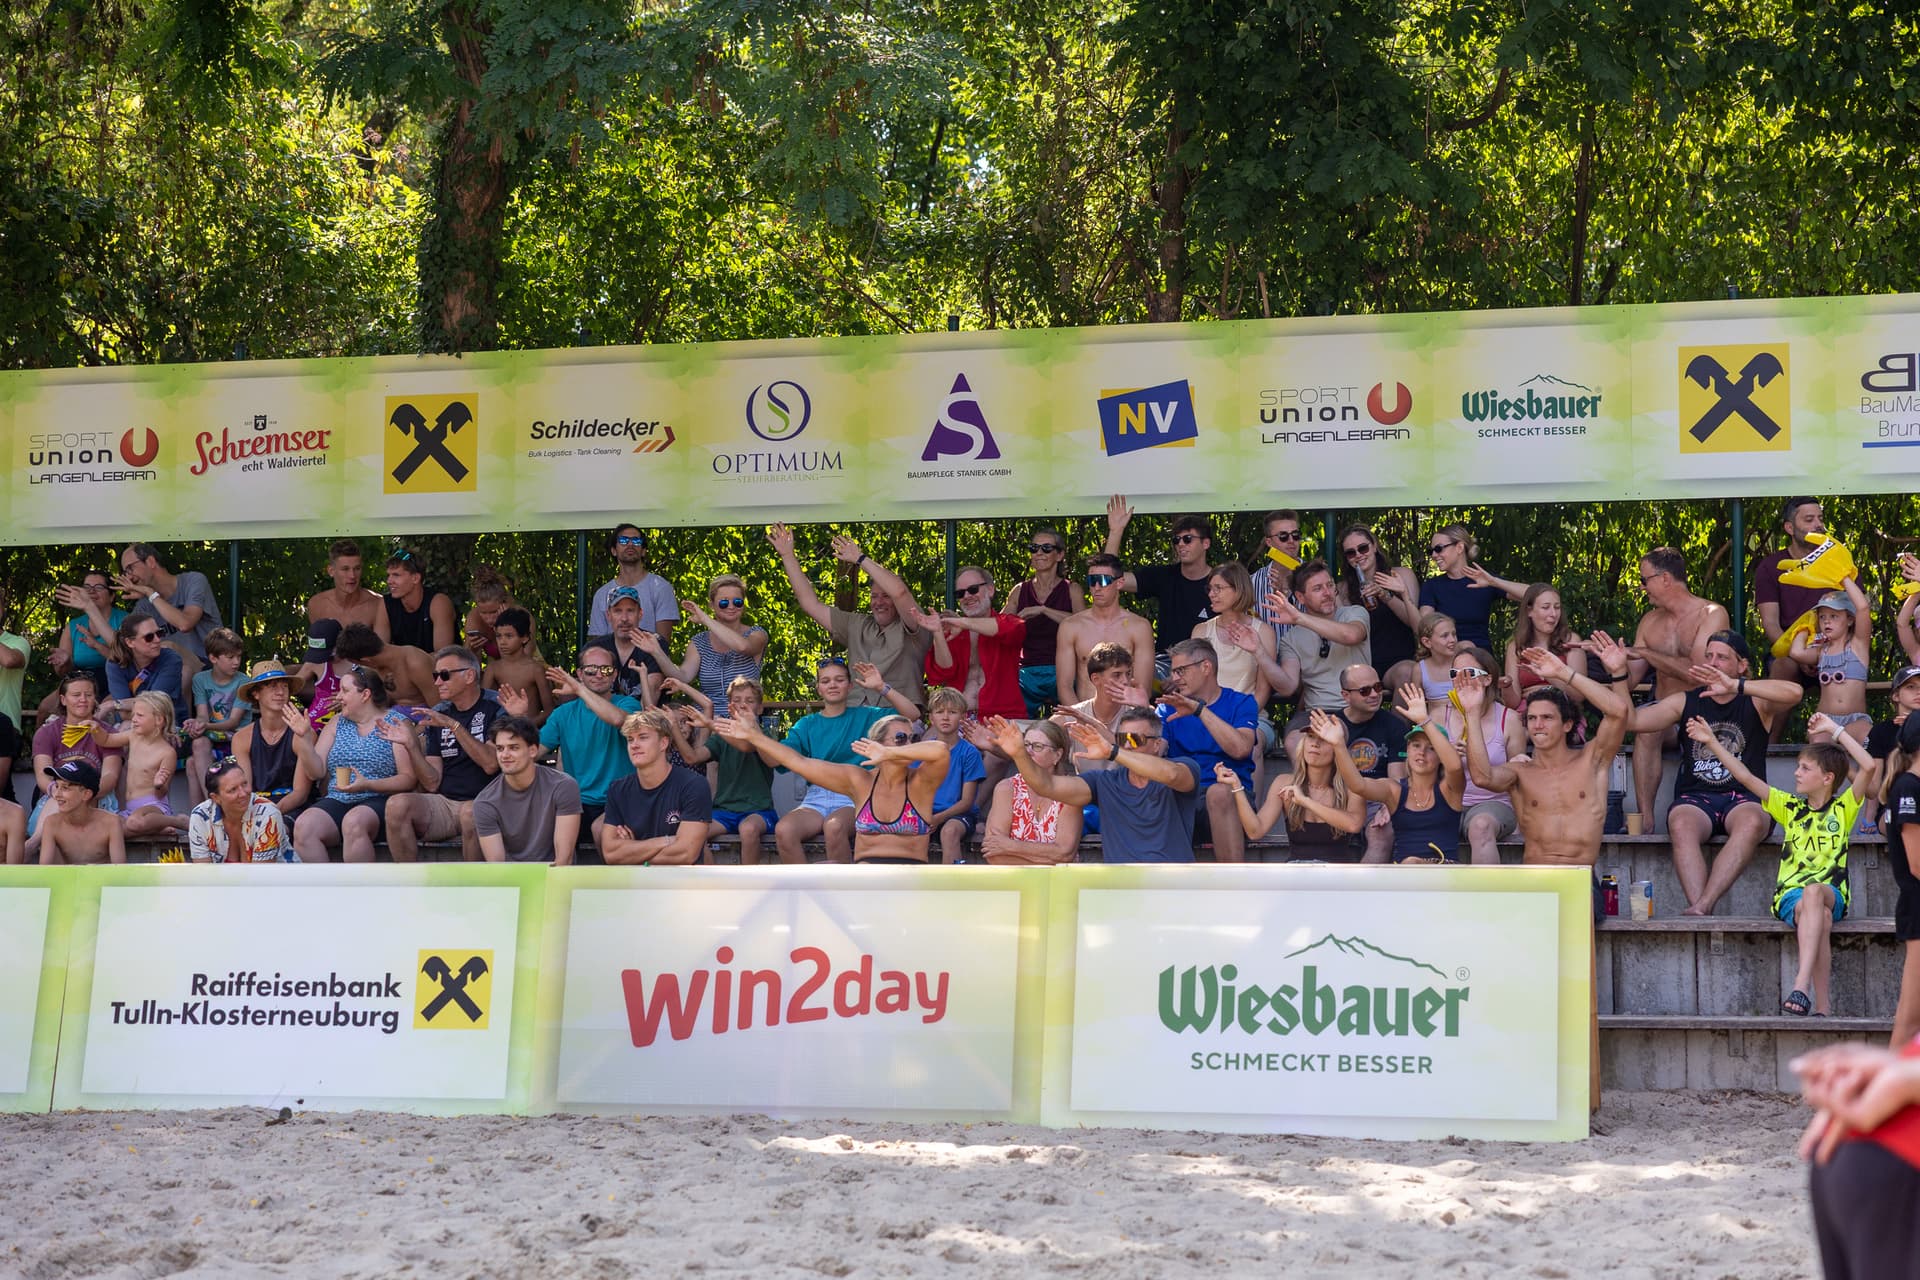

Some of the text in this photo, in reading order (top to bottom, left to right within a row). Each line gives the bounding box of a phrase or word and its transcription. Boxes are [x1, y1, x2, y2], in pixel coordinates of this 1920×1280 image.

[1260, 387, 1358, 405] SPORT
[1462, 389, 1602, 422] Wiesbauer
[1118, 401, 1178, 435] NV
[1260, 406, 1359, 423] union
[530, 418, 659, 441] Schildecker
[1262, 429, 1410, 444] LANGENLEBARN
[1478, 426, 1586, 438] SCHMECKT BESSER
[29, 432, 113, 449] SPORT
[29, 449, 113, 465] union
[190, 427, 331, 476] Schremser
[543, 449, 572, 458] Logistics
[577, 448, 591, 456] Tank
[593, 447, 622, 456] Cleaning
[241, 454, 326, 472] echt Waldviertel
[712, 451, 843, 474] OPTIMUM
[30, 470, 156, 484] LANGENLEBARN
[907, 468, 1012, 478] BAUMPFLEGE STANIEK GMBH
[191, 971, 402, 999] Raiffeisenbank
[621, 945, 950, 1048] win2day
[1158, 964, 1470, 1038] Wiesbauer
[110, 1001, 400, 1034] Tulln-Klosterneuburg
[1190, 1051, 1433, 1075] SCHMECKT BESSER
